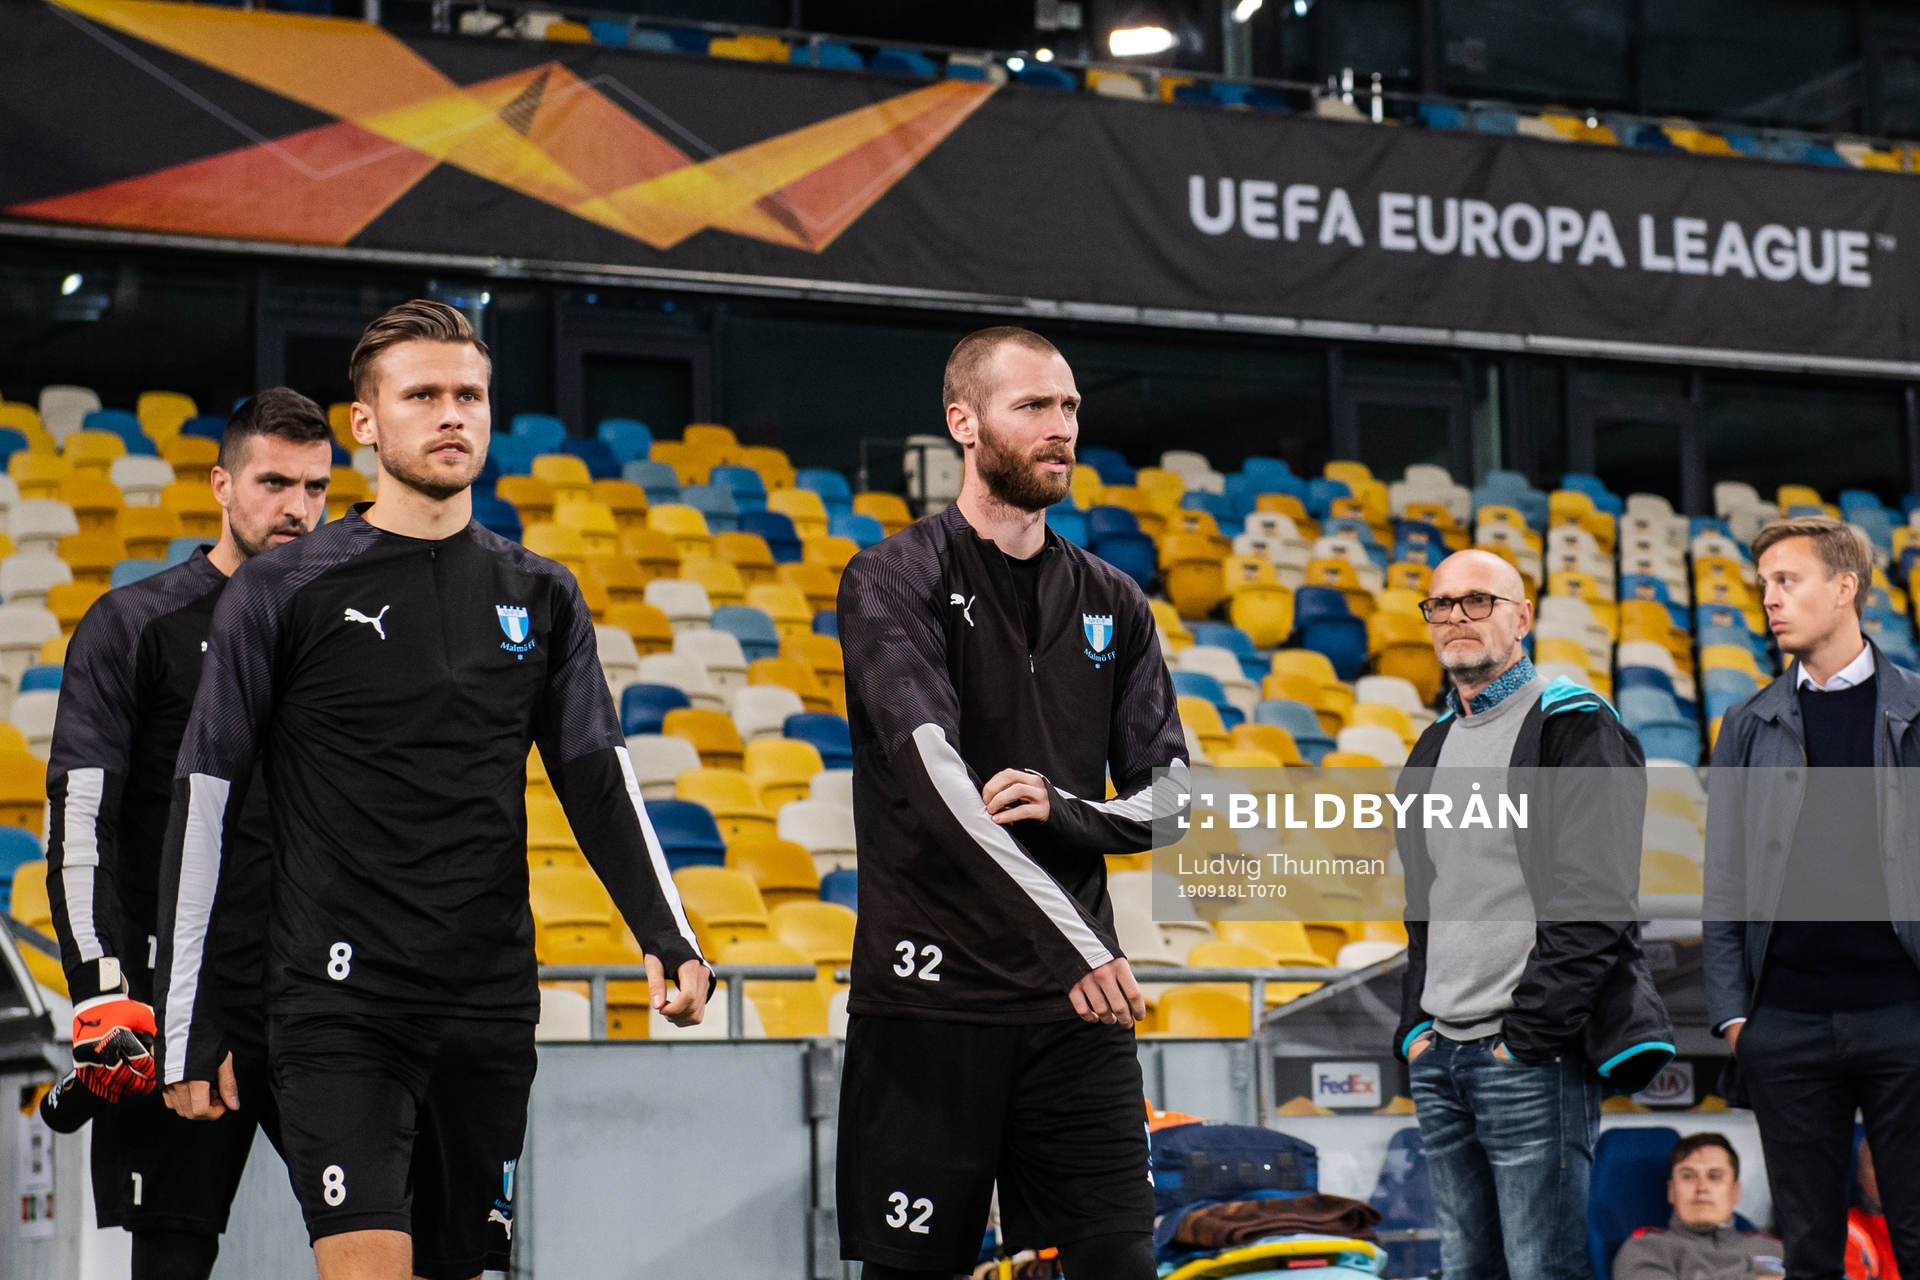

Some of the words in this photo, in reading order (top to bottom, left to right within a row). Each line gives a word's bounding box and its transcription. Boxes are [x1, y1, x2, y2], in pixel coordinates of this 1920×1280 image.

[1188, 175, 1364, 247] UEFA
[1379, 192, 1626, 268] EUROPA
[1639, 214, 1871, 287] LEAGUE
[147, 935, 158, 969] 1
[327, 941, 353, 981] 8
[893, 940, 943, 982] 32
[1319, 1073, 1375, 1094] FedEx
[131, 1171, 143, 1206] 1
[322, 1164, 347, 1207] 8
[886, 1191, 934, 1234] 32
